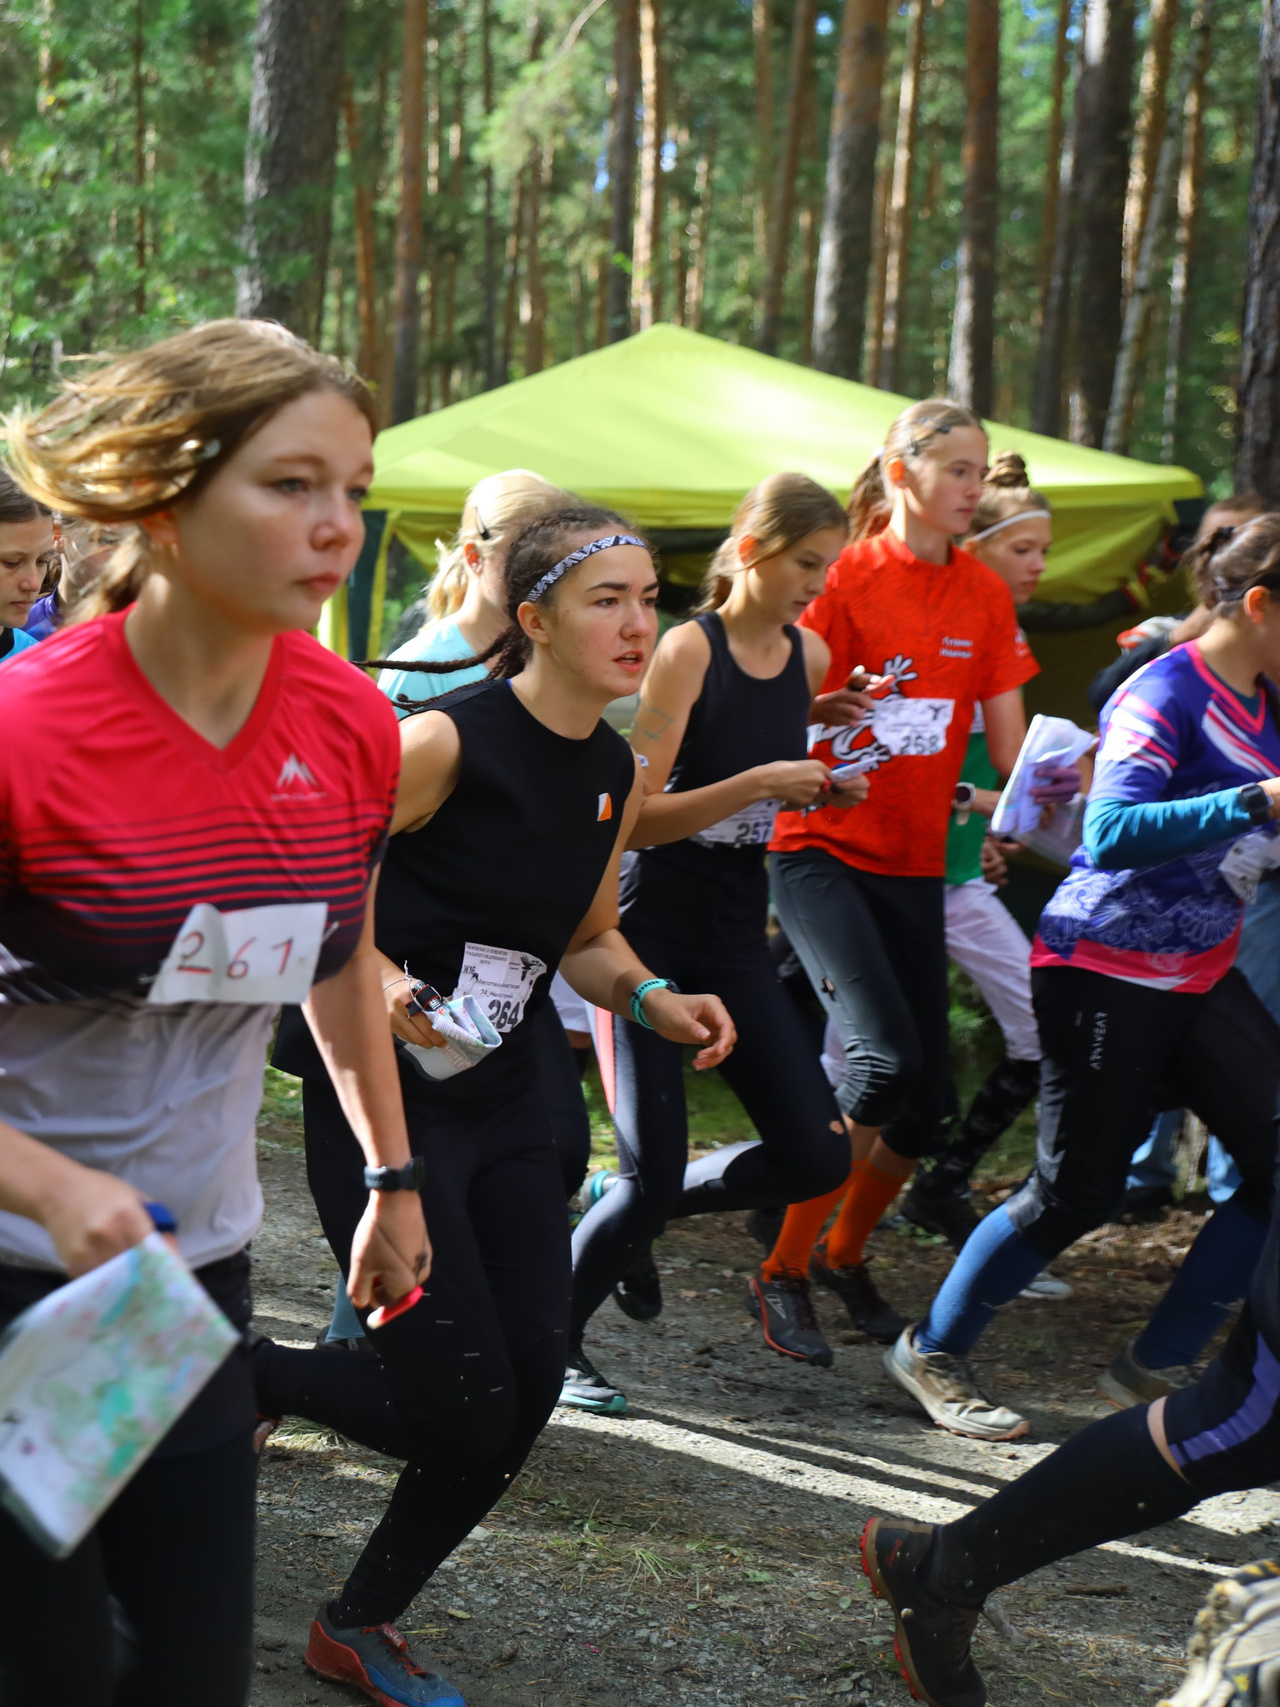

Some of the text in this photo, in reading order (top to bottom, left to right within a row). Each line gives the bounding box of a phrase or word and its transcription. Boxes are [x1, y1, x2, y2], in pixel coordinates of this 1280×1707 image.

[735, 821, 772, 843] 257
[176, 930, 294, 980] 261
[488, 999, 520, 1029] 264
